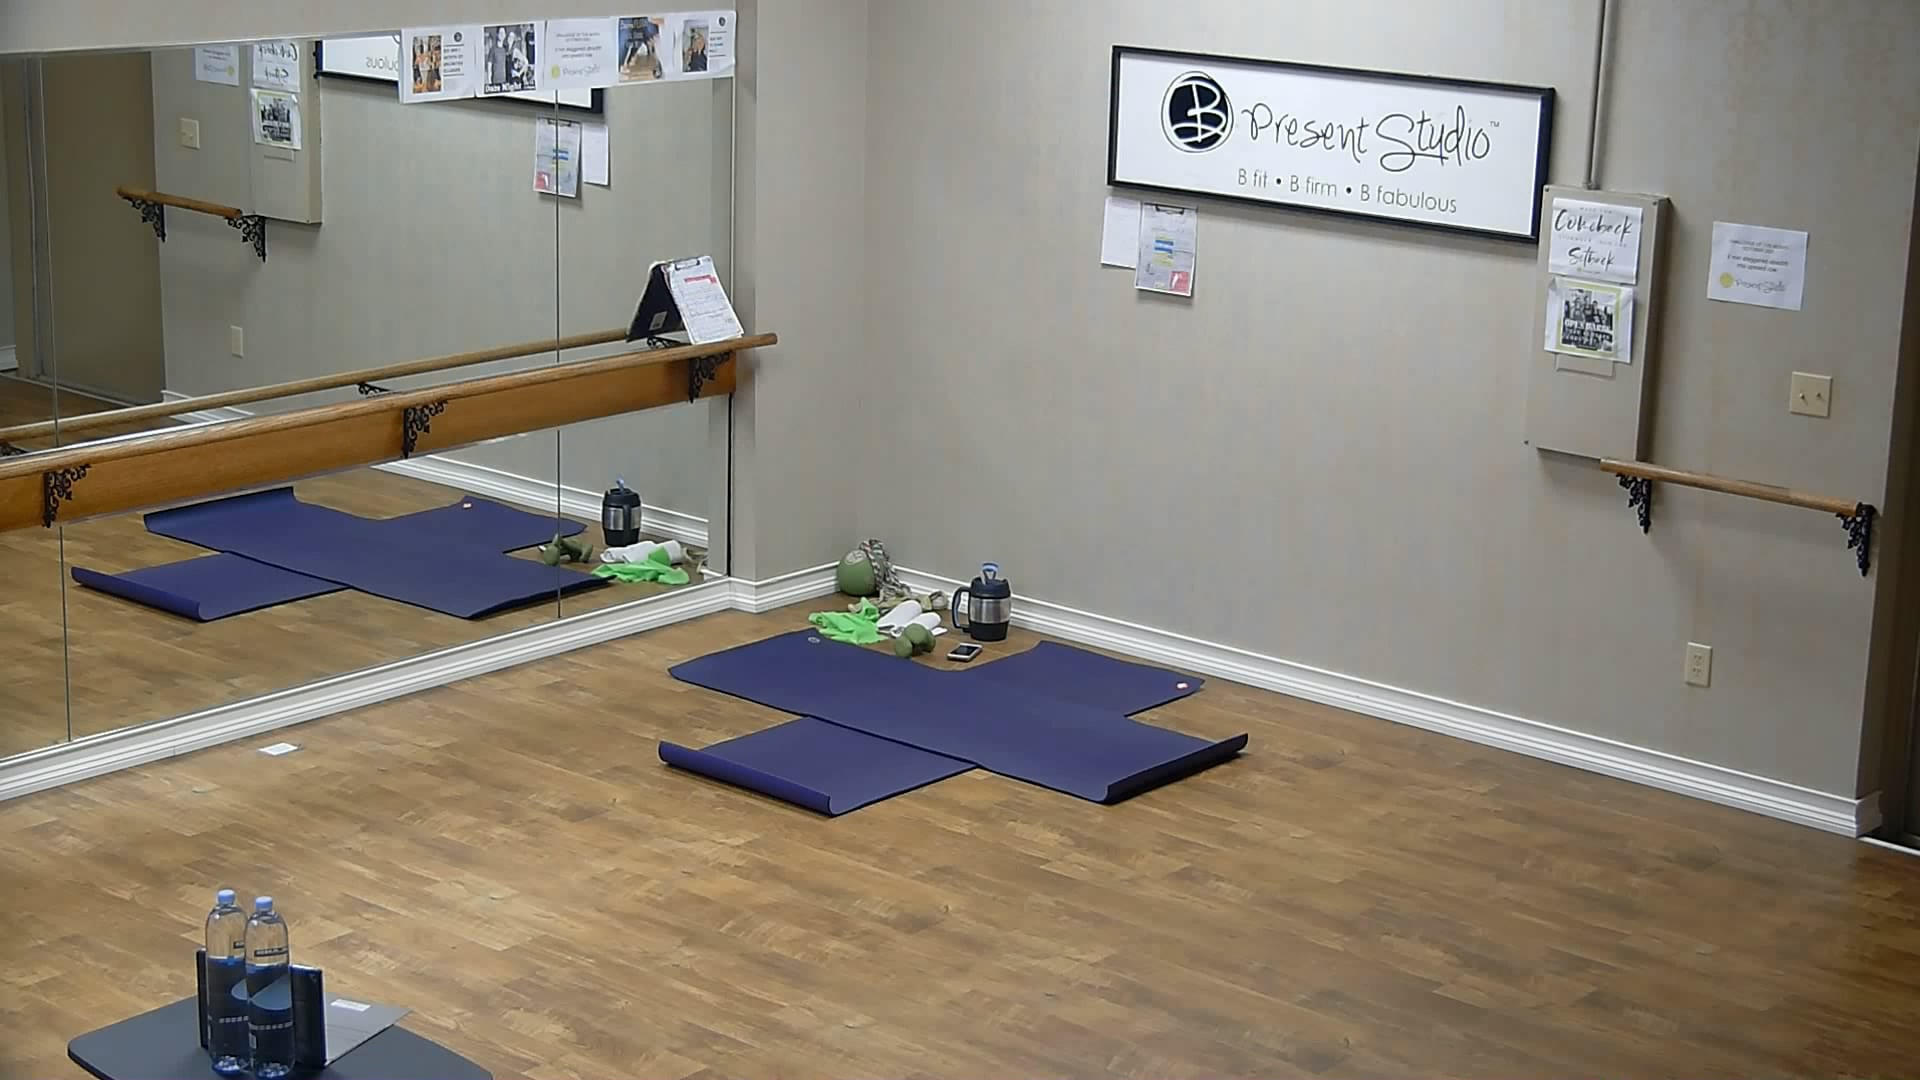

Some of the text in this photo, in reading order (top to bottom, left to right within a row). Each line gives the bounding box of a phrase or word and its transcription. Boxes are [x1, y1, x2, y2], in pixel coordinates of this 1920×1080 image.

[1241, 103, 1370, 163] Present
[1376, 105, 1490, 172] Studio
[1238, 168, 1457, 213] B fit B firm B fabulous
